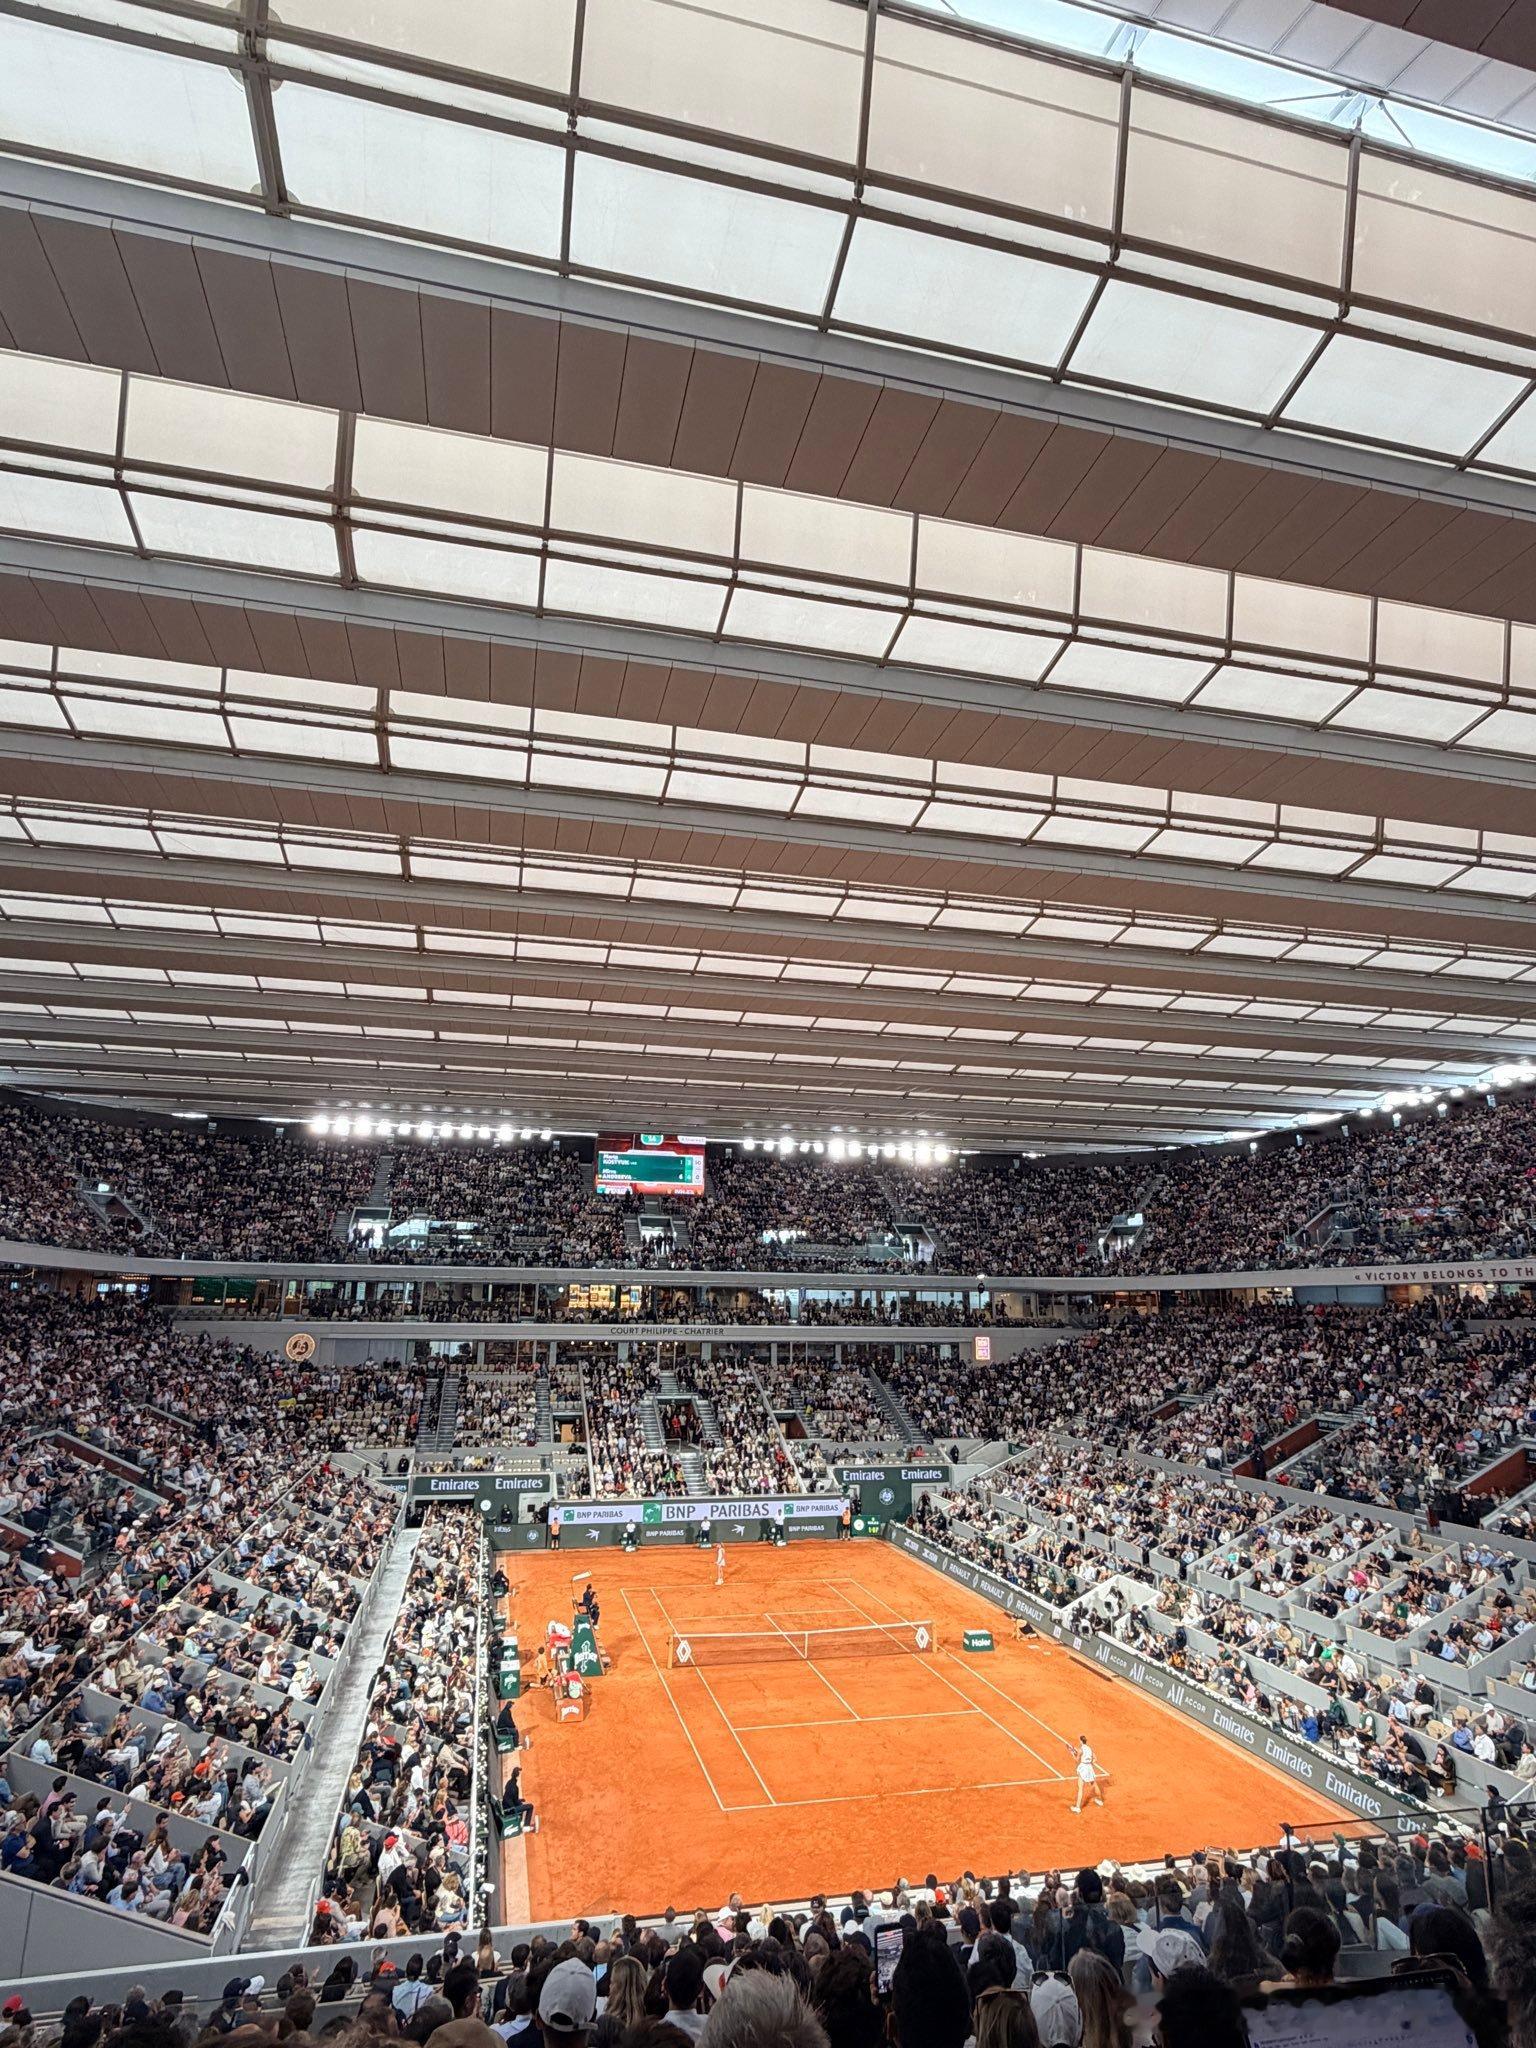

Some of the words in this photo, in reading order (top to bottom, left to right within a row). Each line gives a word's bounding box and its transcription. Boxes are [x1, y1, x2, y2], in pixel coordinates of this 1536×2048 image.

[1365, 1271, 1417, 1281] VICTORY
[1423, 1269, 1483, 1280] BELONGS
[1490, 1267, 1508, 1277] TO
[610, 1327, 639, 1335] COURT
[842, 1470, 885, 1481] Emirates
[901, 1469, 942, 1480] Emirates
[430, 1479, 480, 1491] Emirates
[495, 1478, 543, 1490] Emirates
[666, 1505, 696, 1519] BNP
[710, 1503, 770, 1518] PARIBAS
[811, 1504, 839, 1512] PARIBAS
[659, 1529, 685, 1537] PARIBAS
[801, 1524, 825, 1532] PARIBAS
[949, 1563, 971, 1580] RENAULT
[980, 1579, 1005, 1599] RENAULT
[1016, 1600, 1044, 1622] RENAULT
[971, 1638, 991, 1648] Haier
[1145, 1675, 1164, 1689] ACCOR
[1184, 1696, 1207, 1713] ACCOR
[1212, 1708, 1255, 1744] Emirates
[1265, 1737, 1313, 1778] Emirates
[1325, 1771, 1382, 1817] Emirates
